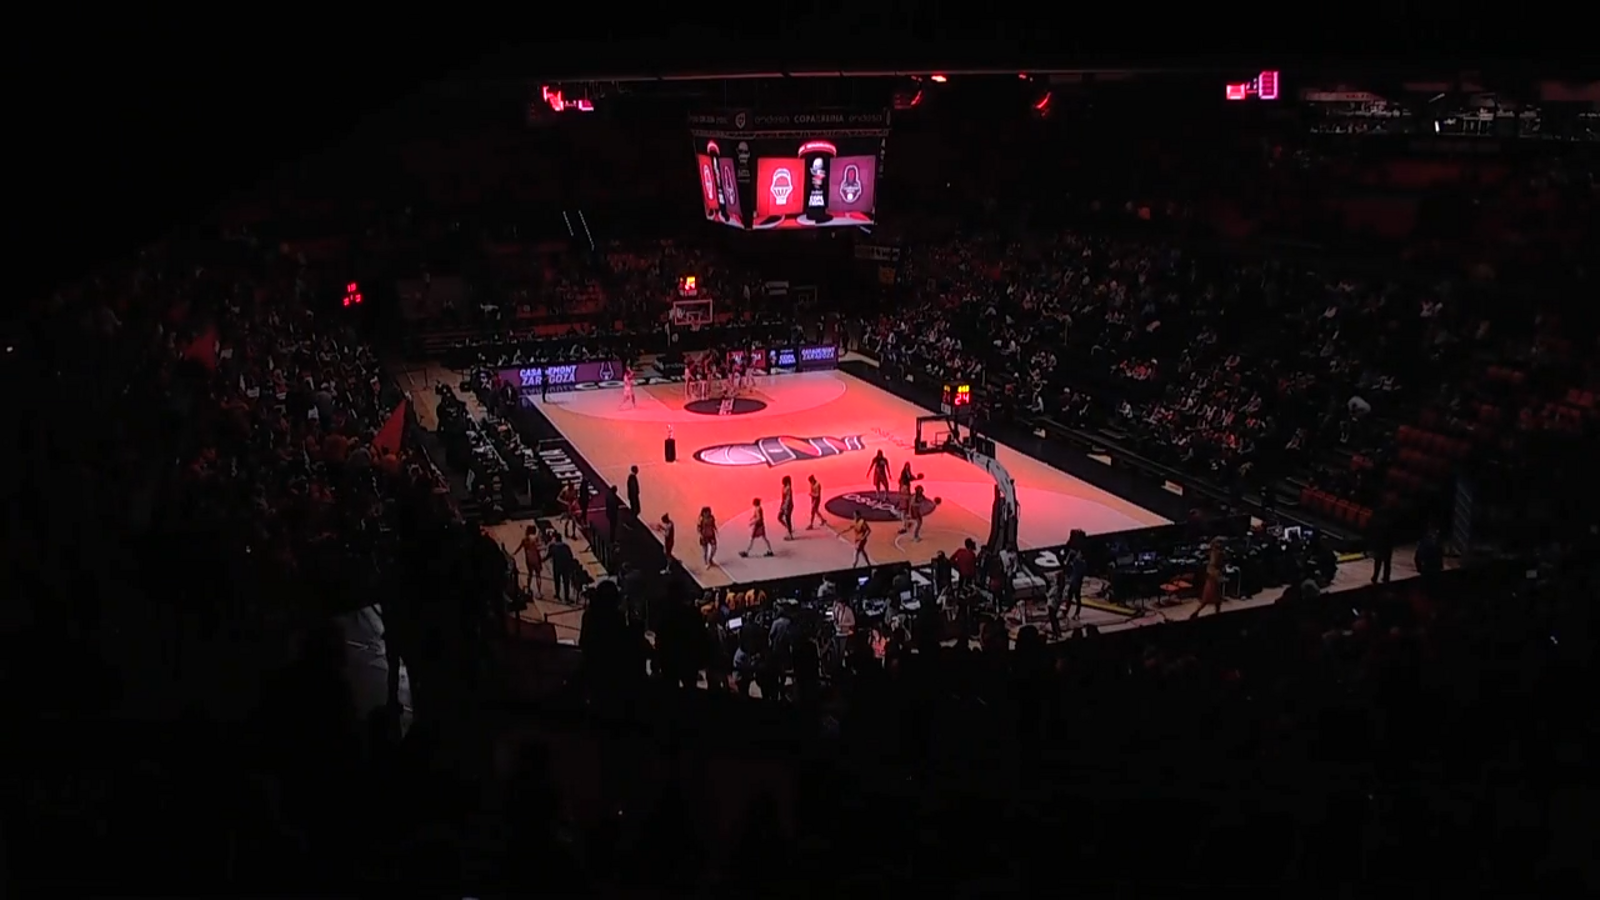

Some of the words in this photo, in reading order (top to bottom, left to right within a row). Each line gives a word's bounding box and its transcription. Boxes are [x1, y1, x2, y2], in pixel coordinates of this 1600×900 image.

[520, 364, 577, 377] CASAEMONT
[521, 373, 576, 387] ZARGOZA
[954, 393, 970, 406] 24
